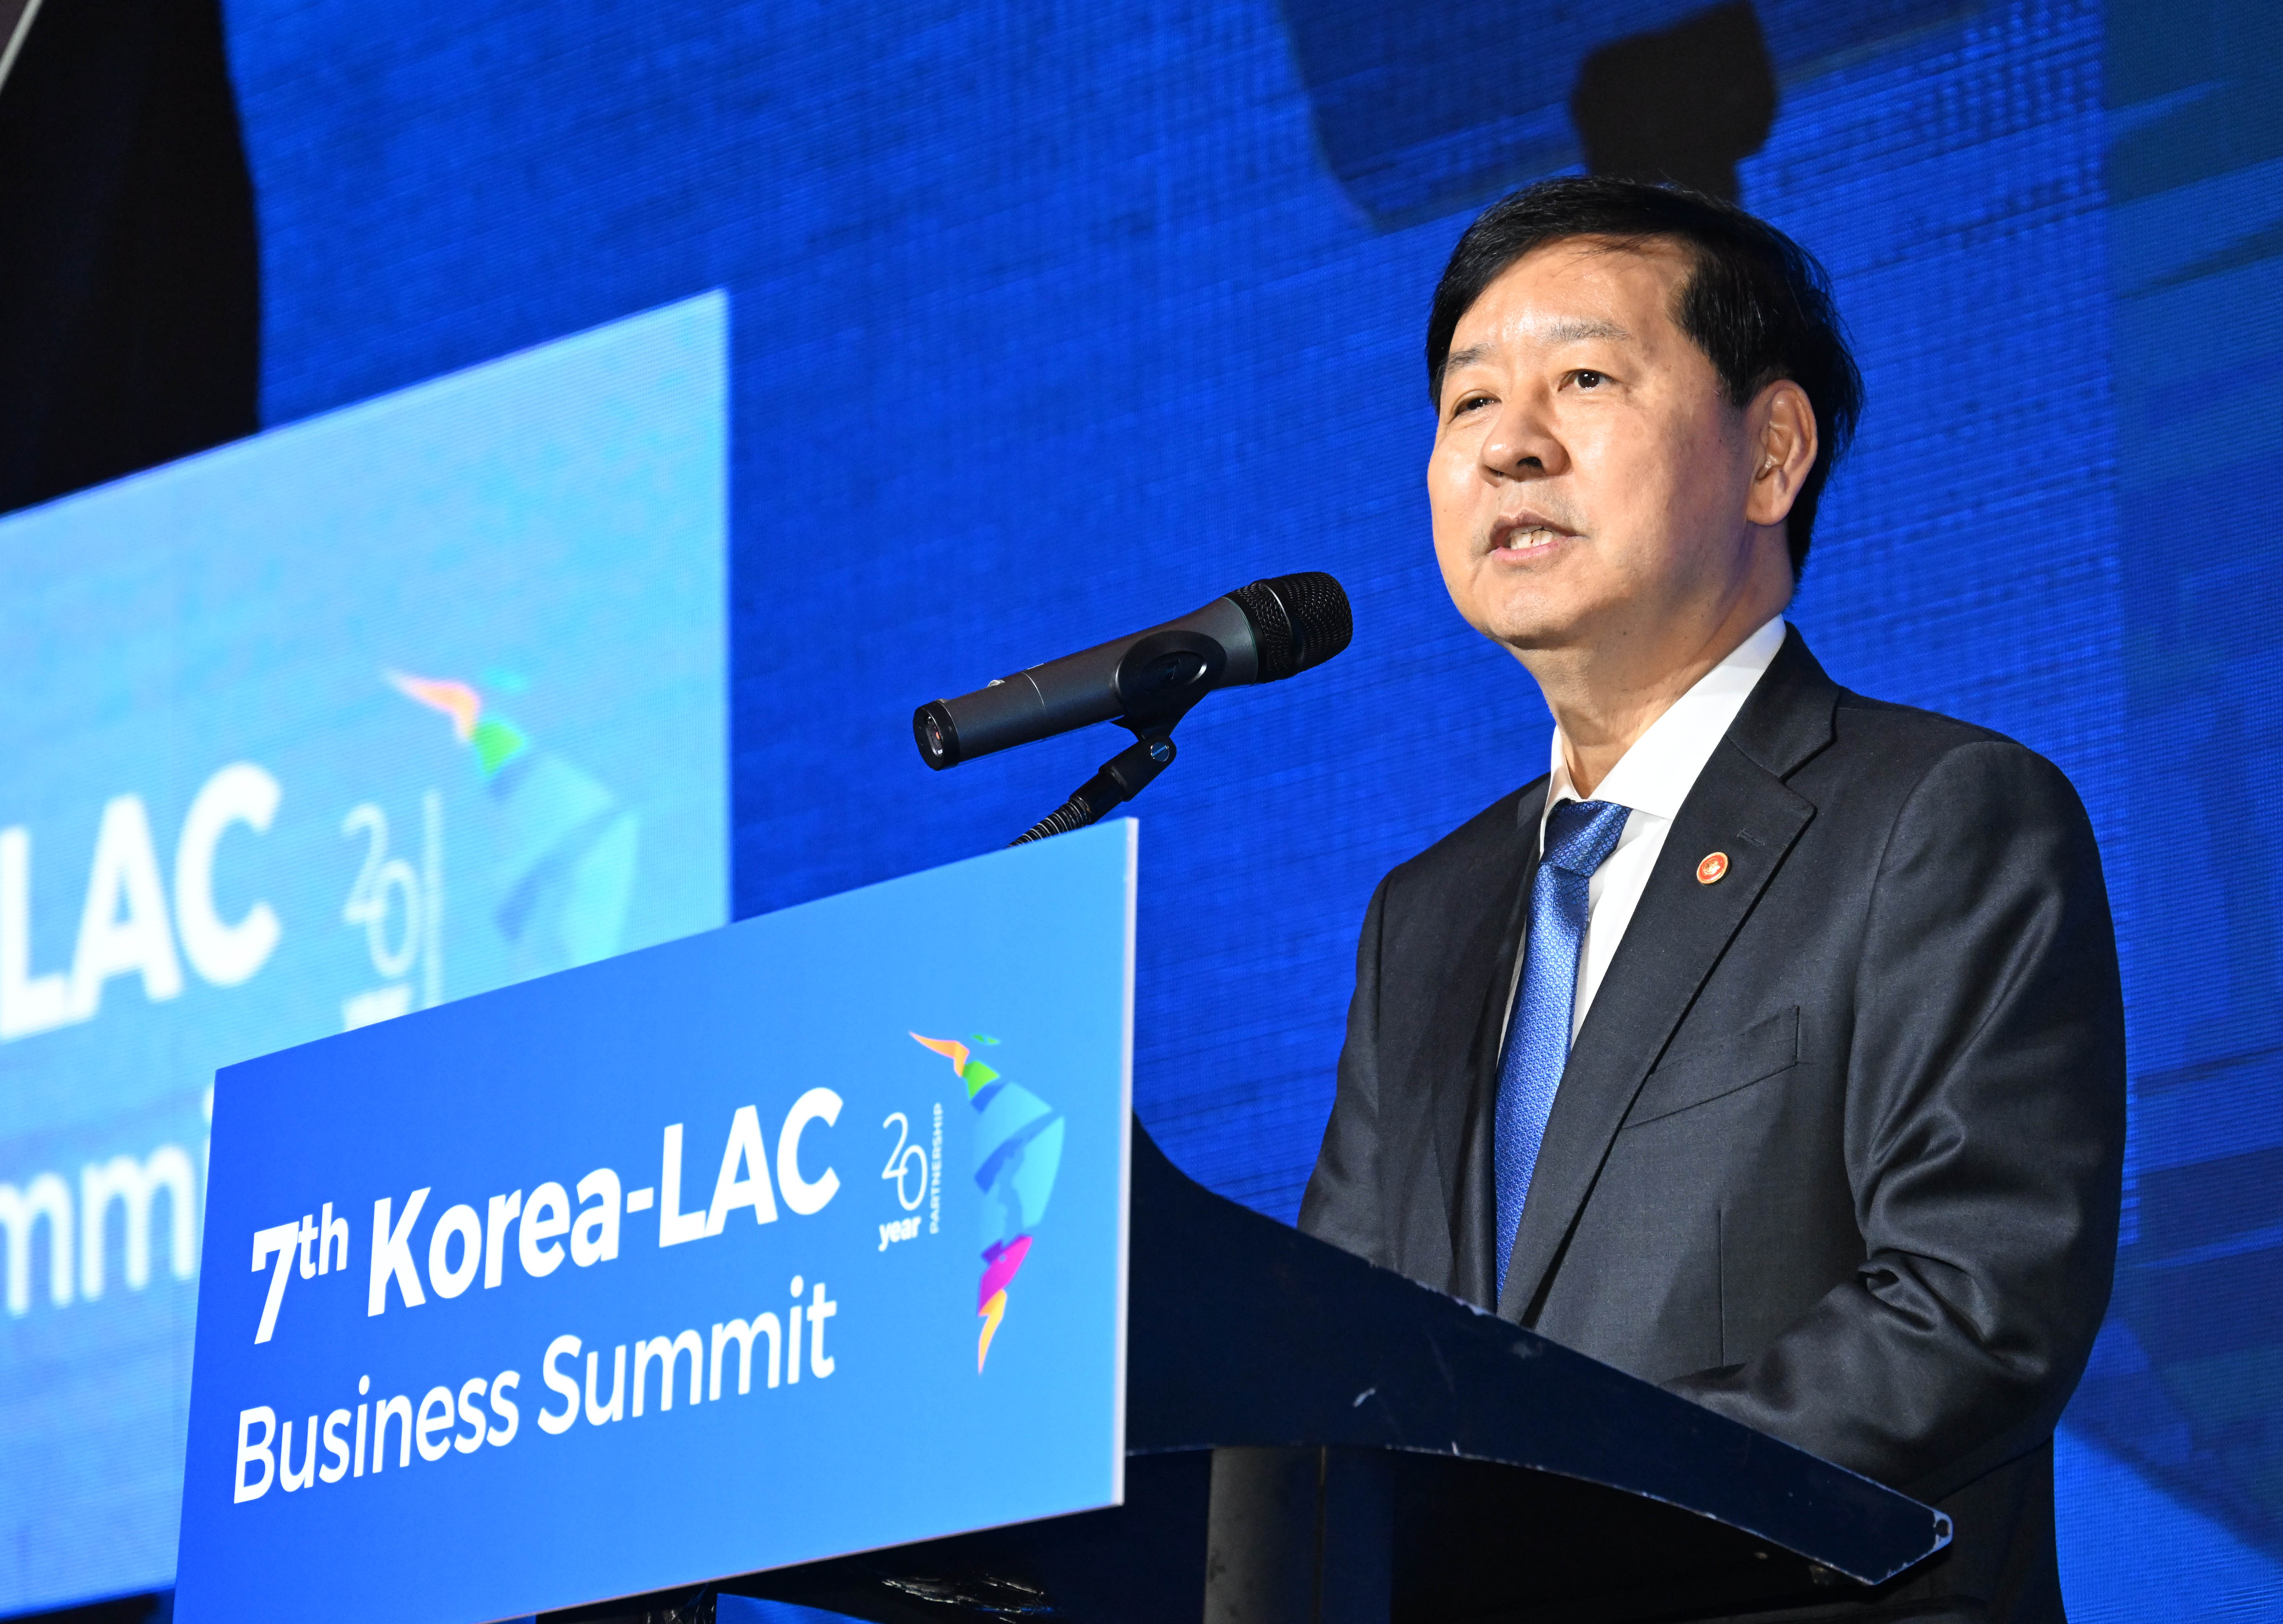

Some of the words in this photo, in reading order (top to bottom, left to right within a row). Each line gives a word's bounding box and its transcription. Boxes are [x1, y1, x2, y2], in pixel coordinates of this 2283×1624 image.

[340, 801, 420, 979] 20
[251, 1202, 348, 1345] 7th
[368, 1087, 843, 1317] Korea-LAC
[878, 1216, 921, 1252] year
[882, 1112, 928, 1211] 20
[929, 1102, 943, 1234] PARTNERSHIP
[234, 1370, 520, 1504] Business
[537, 1275, 837, 1434] Summit
